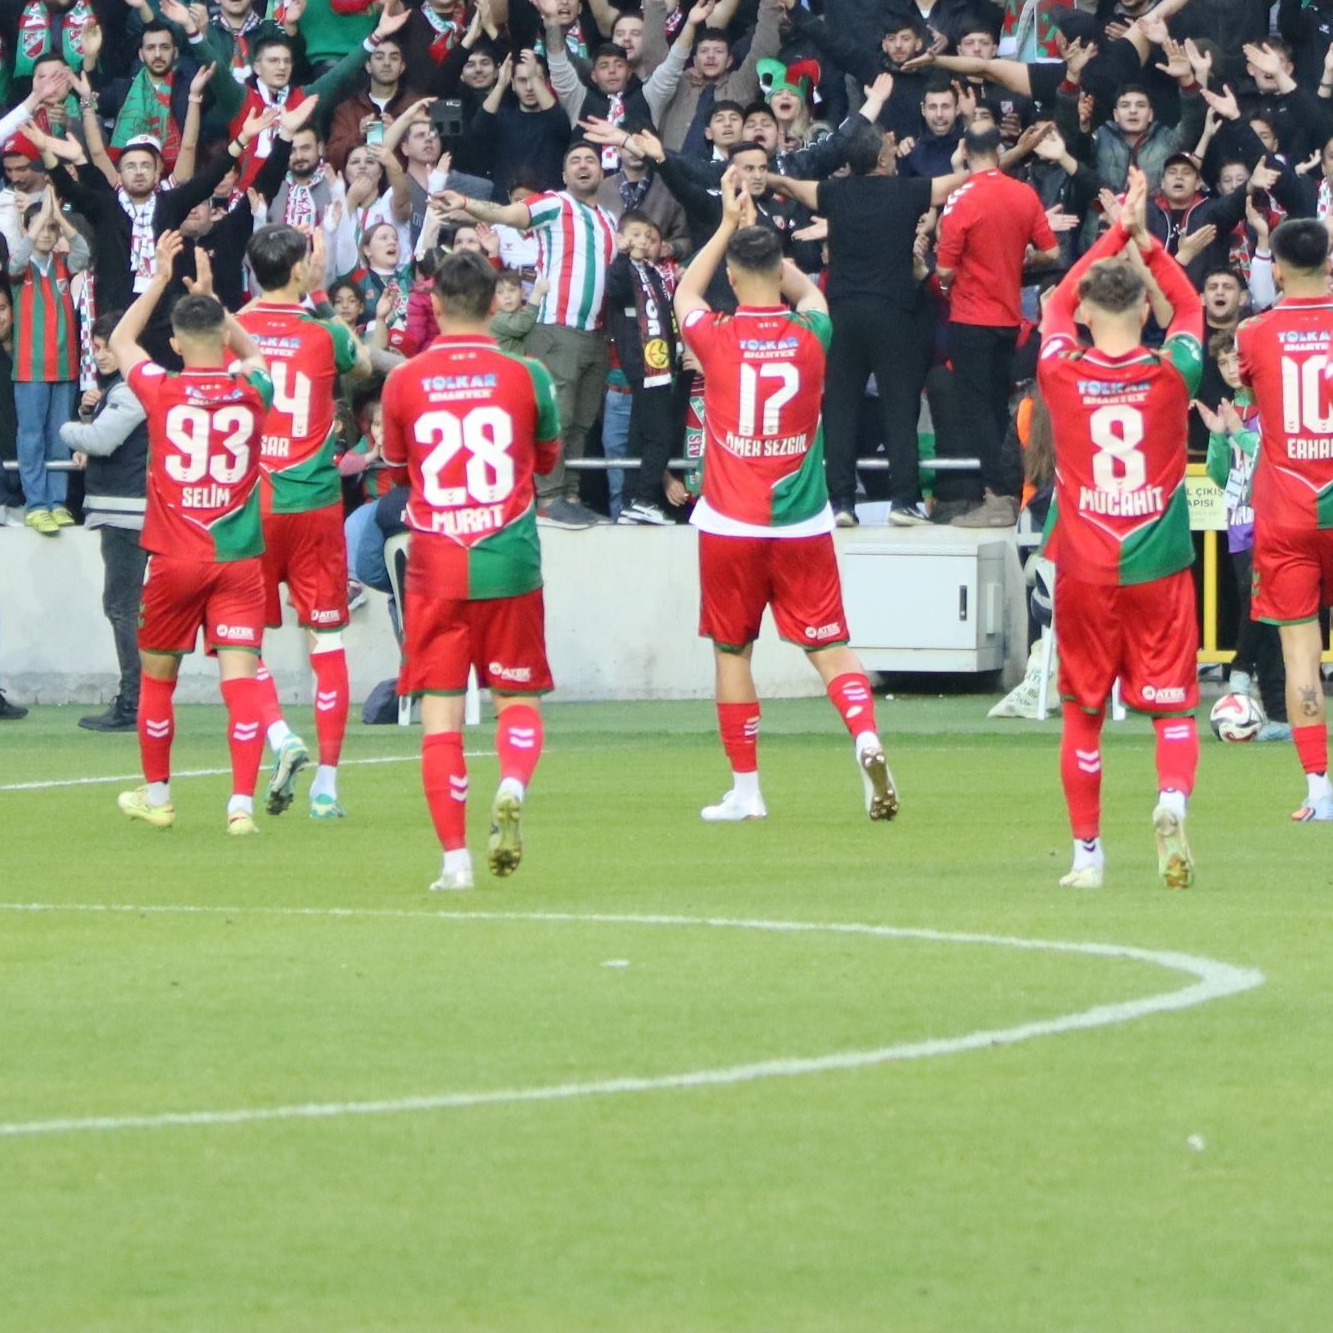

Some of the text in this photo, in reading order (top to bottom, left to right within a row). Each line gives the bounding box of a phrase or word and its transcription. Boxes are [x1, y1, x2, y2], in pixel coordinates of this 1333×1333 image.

[251, 334, 300, 348] OLKAR
[739, 337, 799, 351] TOLKAR
[1277, 331, 1331, 343] TOLKA
[421, 373, 497, 391] TOLKAR
[270, 361, 311, 438] 4
[738, 362, 799, 436] 17
[165, 404, 254, 484] 93
[414, 405, 514, 507] 28
[725, 431, 762, 457] ÖMER
[1089, 405, 1146, 492] 8
[181, 483, 230, 508] SELİM
[1078, 485, 1164, 517] MÜCAHİT
[1187, 499, 1214, 507] APISI
[431, 507, 504, 534] MURAT
[228, 626, 254, 639] ATEK
[1155, 687, 1185, 701] ATEK
